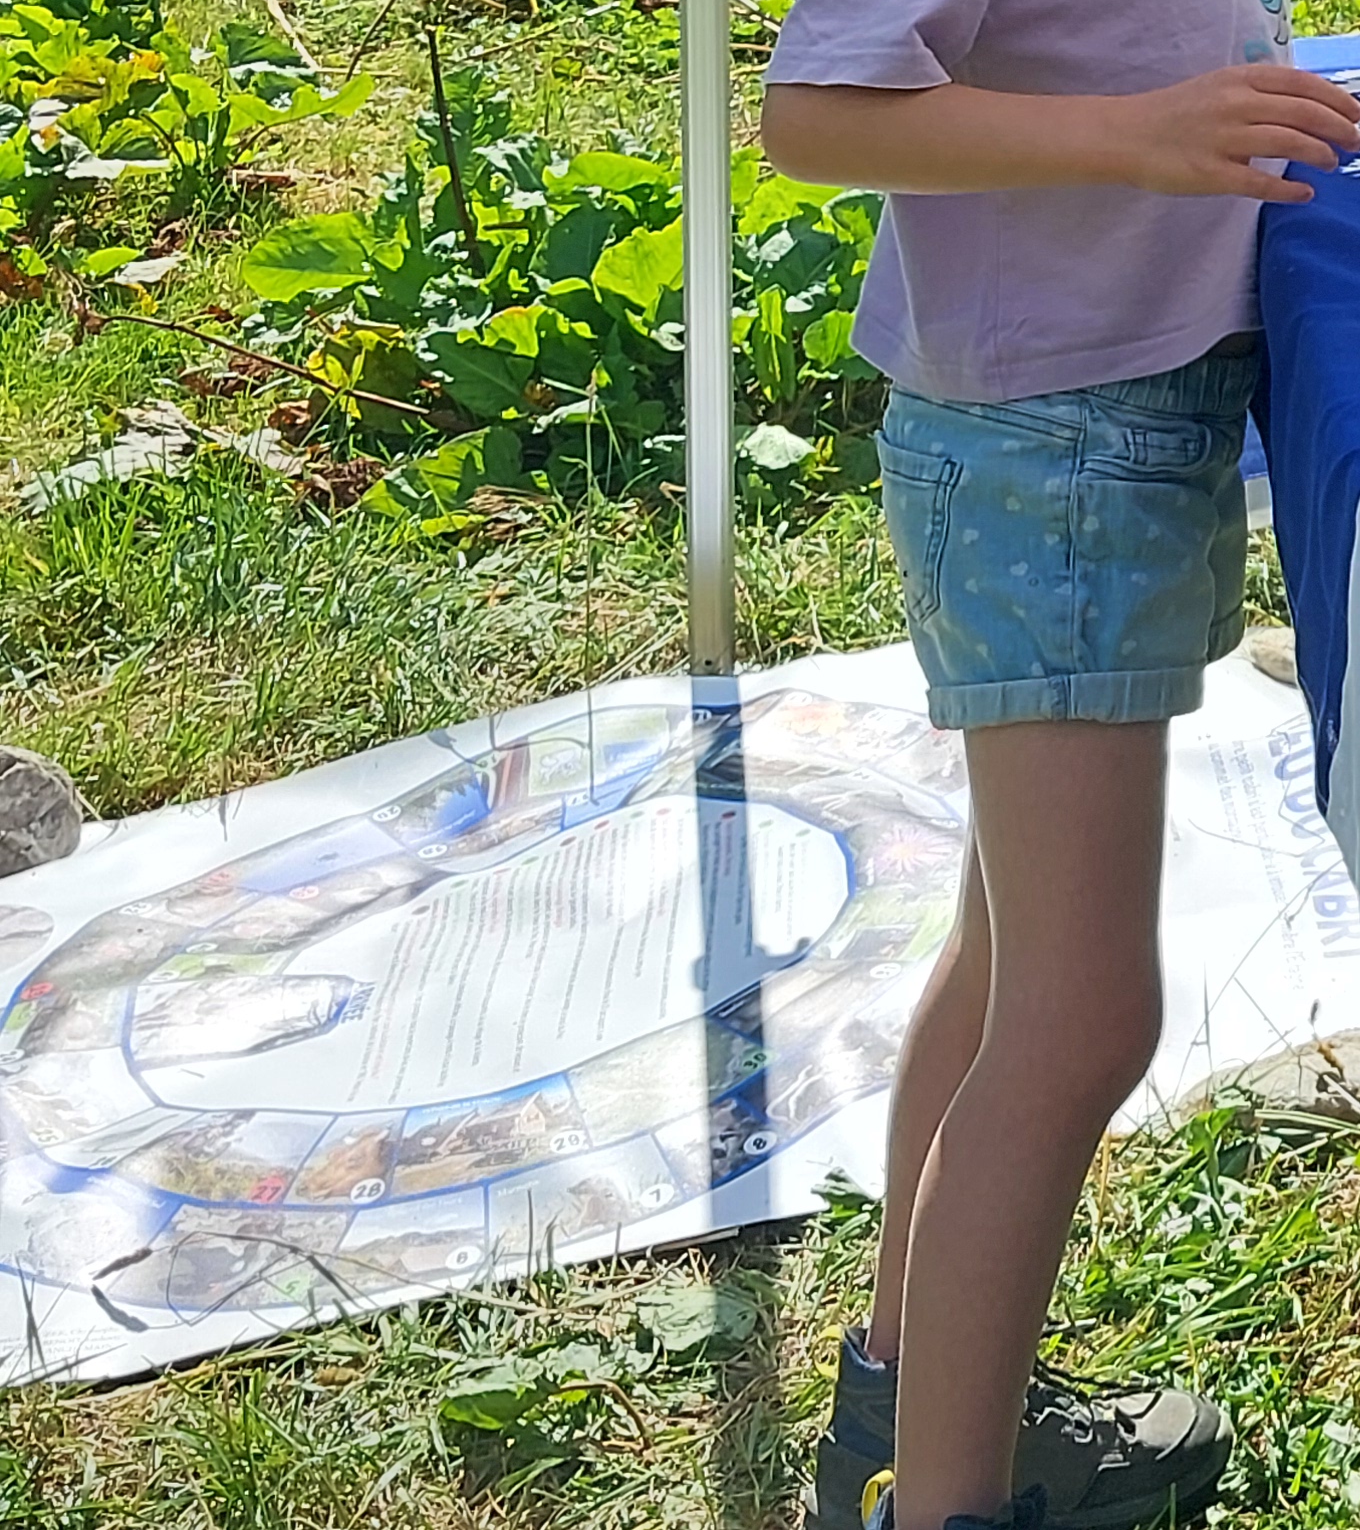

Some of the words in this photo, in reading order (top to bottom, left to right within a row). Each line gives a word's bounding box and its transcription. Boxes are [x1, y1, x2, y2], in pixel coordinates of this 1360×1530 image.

[753, 1137, 767, 1150] 8
[255, 1185, 280, 1201] 27
[355, 1182, 382, 1199] 28
